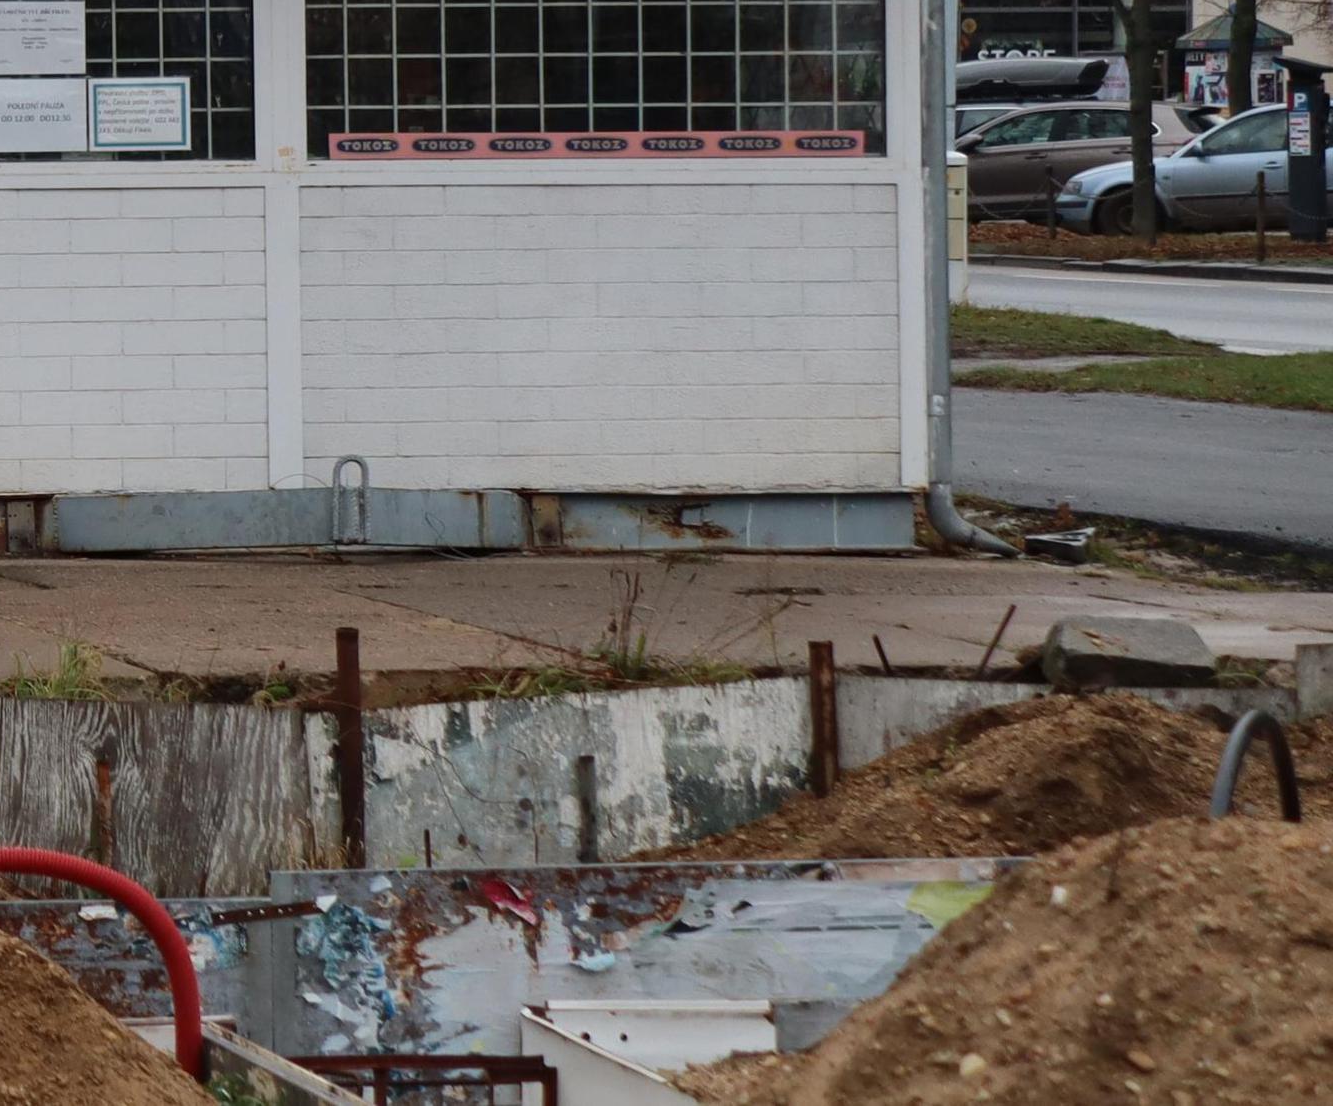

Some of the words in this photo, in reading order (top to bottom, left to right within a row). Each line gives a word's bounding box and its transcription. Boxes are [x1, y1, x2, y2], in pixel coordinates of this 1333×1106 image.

[1293, 93, 1308, 108] P
[342, 141, 392, 151] TOKOZ
[418, 141, 468, 151] TOKOZ
[494, 140, 544, 150] TOKOZ
[570, 140, 621, 150] TOKOZ
[648, 140, 698, 150] TOKOZ
[724, 139, 774, 149] TOKOZ
[801, 138, 851, 148] TOKOZ
